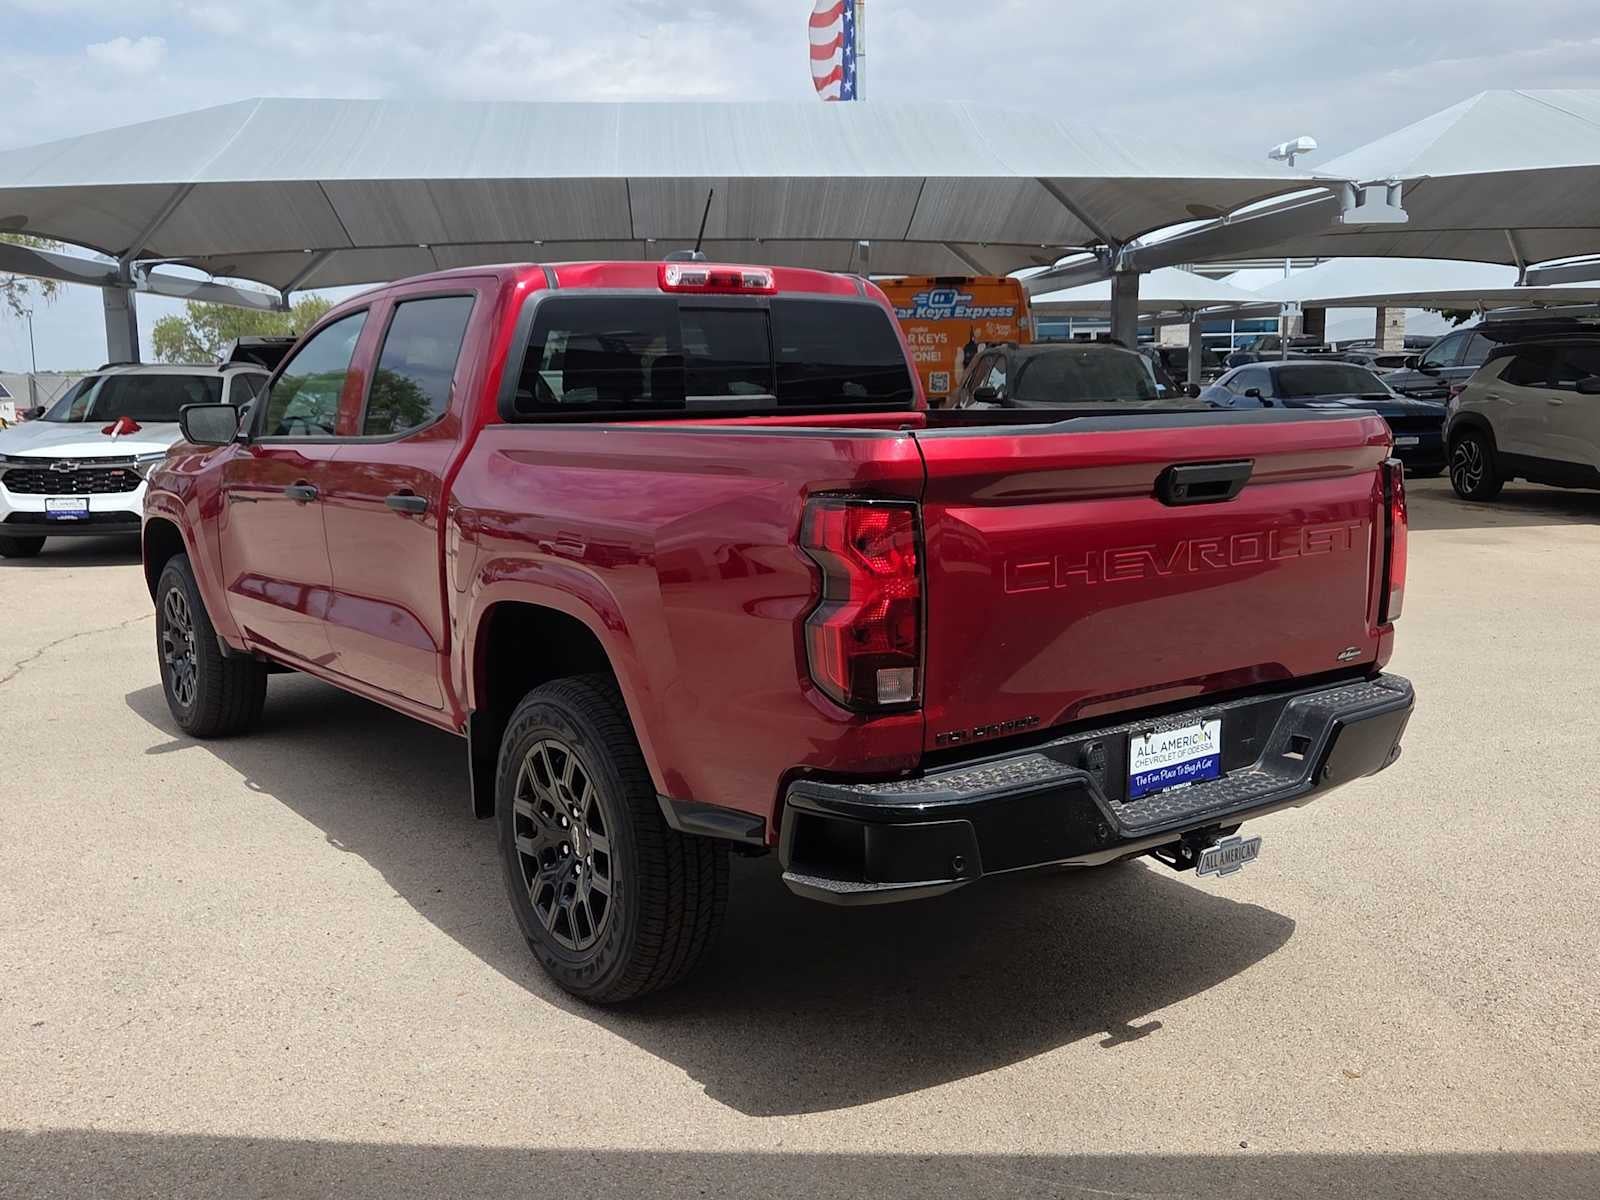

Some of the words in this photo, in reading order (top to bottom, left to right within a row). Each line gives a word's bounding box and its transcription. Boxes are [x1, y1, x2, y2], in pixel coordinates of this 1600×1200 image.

[916, 306, 951, 319] Keys
[954, 306, 1014, 319] Express
[918, 333, 948, 345] KEYS
[911, 352, 942, 362] ONE!
[1003, 520, 1363, 594] CHEVROLET
[1135, 752, 1176, 769] CHEVROLET
[1178, 748, 1186, 757] OF
[1137, 743, 1157, 758] ALL
[1136, 775, 1147, 786] The
[1147, 773, 1160, 784] Fun
[1160, 768, 1176, 781] Place
[1177, 765, 1184, 776] To
[1184, 763, 1196, 775] Buy
[1202, 758, 1213, 769] Car
[1205, 854, 1218, 869] ALL
[1219, 840, 1258, 865] AMERICAN
